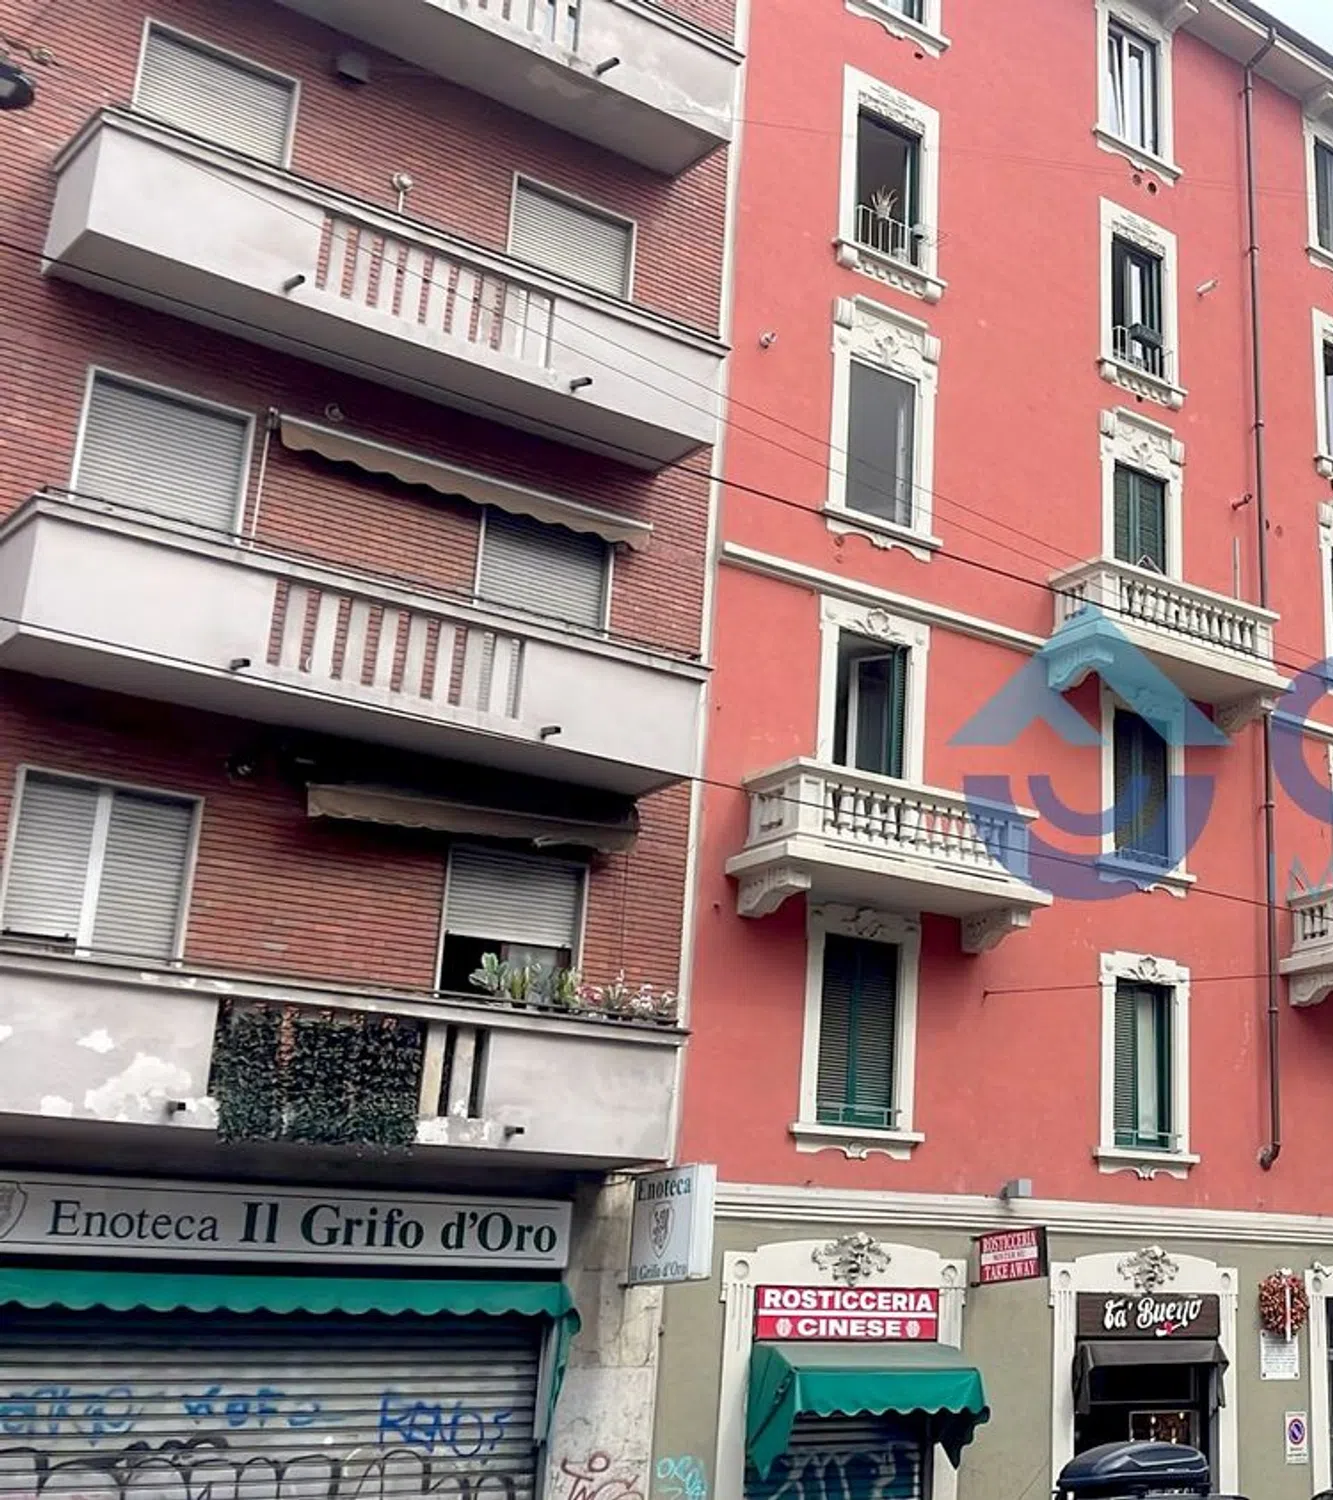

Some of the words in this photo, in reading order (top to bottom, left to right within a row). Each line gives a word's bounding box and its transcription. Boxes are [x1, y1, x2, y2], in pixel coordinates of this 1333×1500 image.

[637, 1178, 691, 1201] Enoteca
[47, 1199, 219, 1243] Enoteca
[239, 1201, 279, 1244] Il
[300, 1204, 423, 1250] Grifo
[440, 1210, 557, 1254] d'Oro
[984, 1263, 1009, 1281] TAKE
[1010, 1260, 1036, 1278] AWAY
[763, 1288, 933, 1312] ROSTICCERIA
[797, 1317, 903, 1337] CINESE
